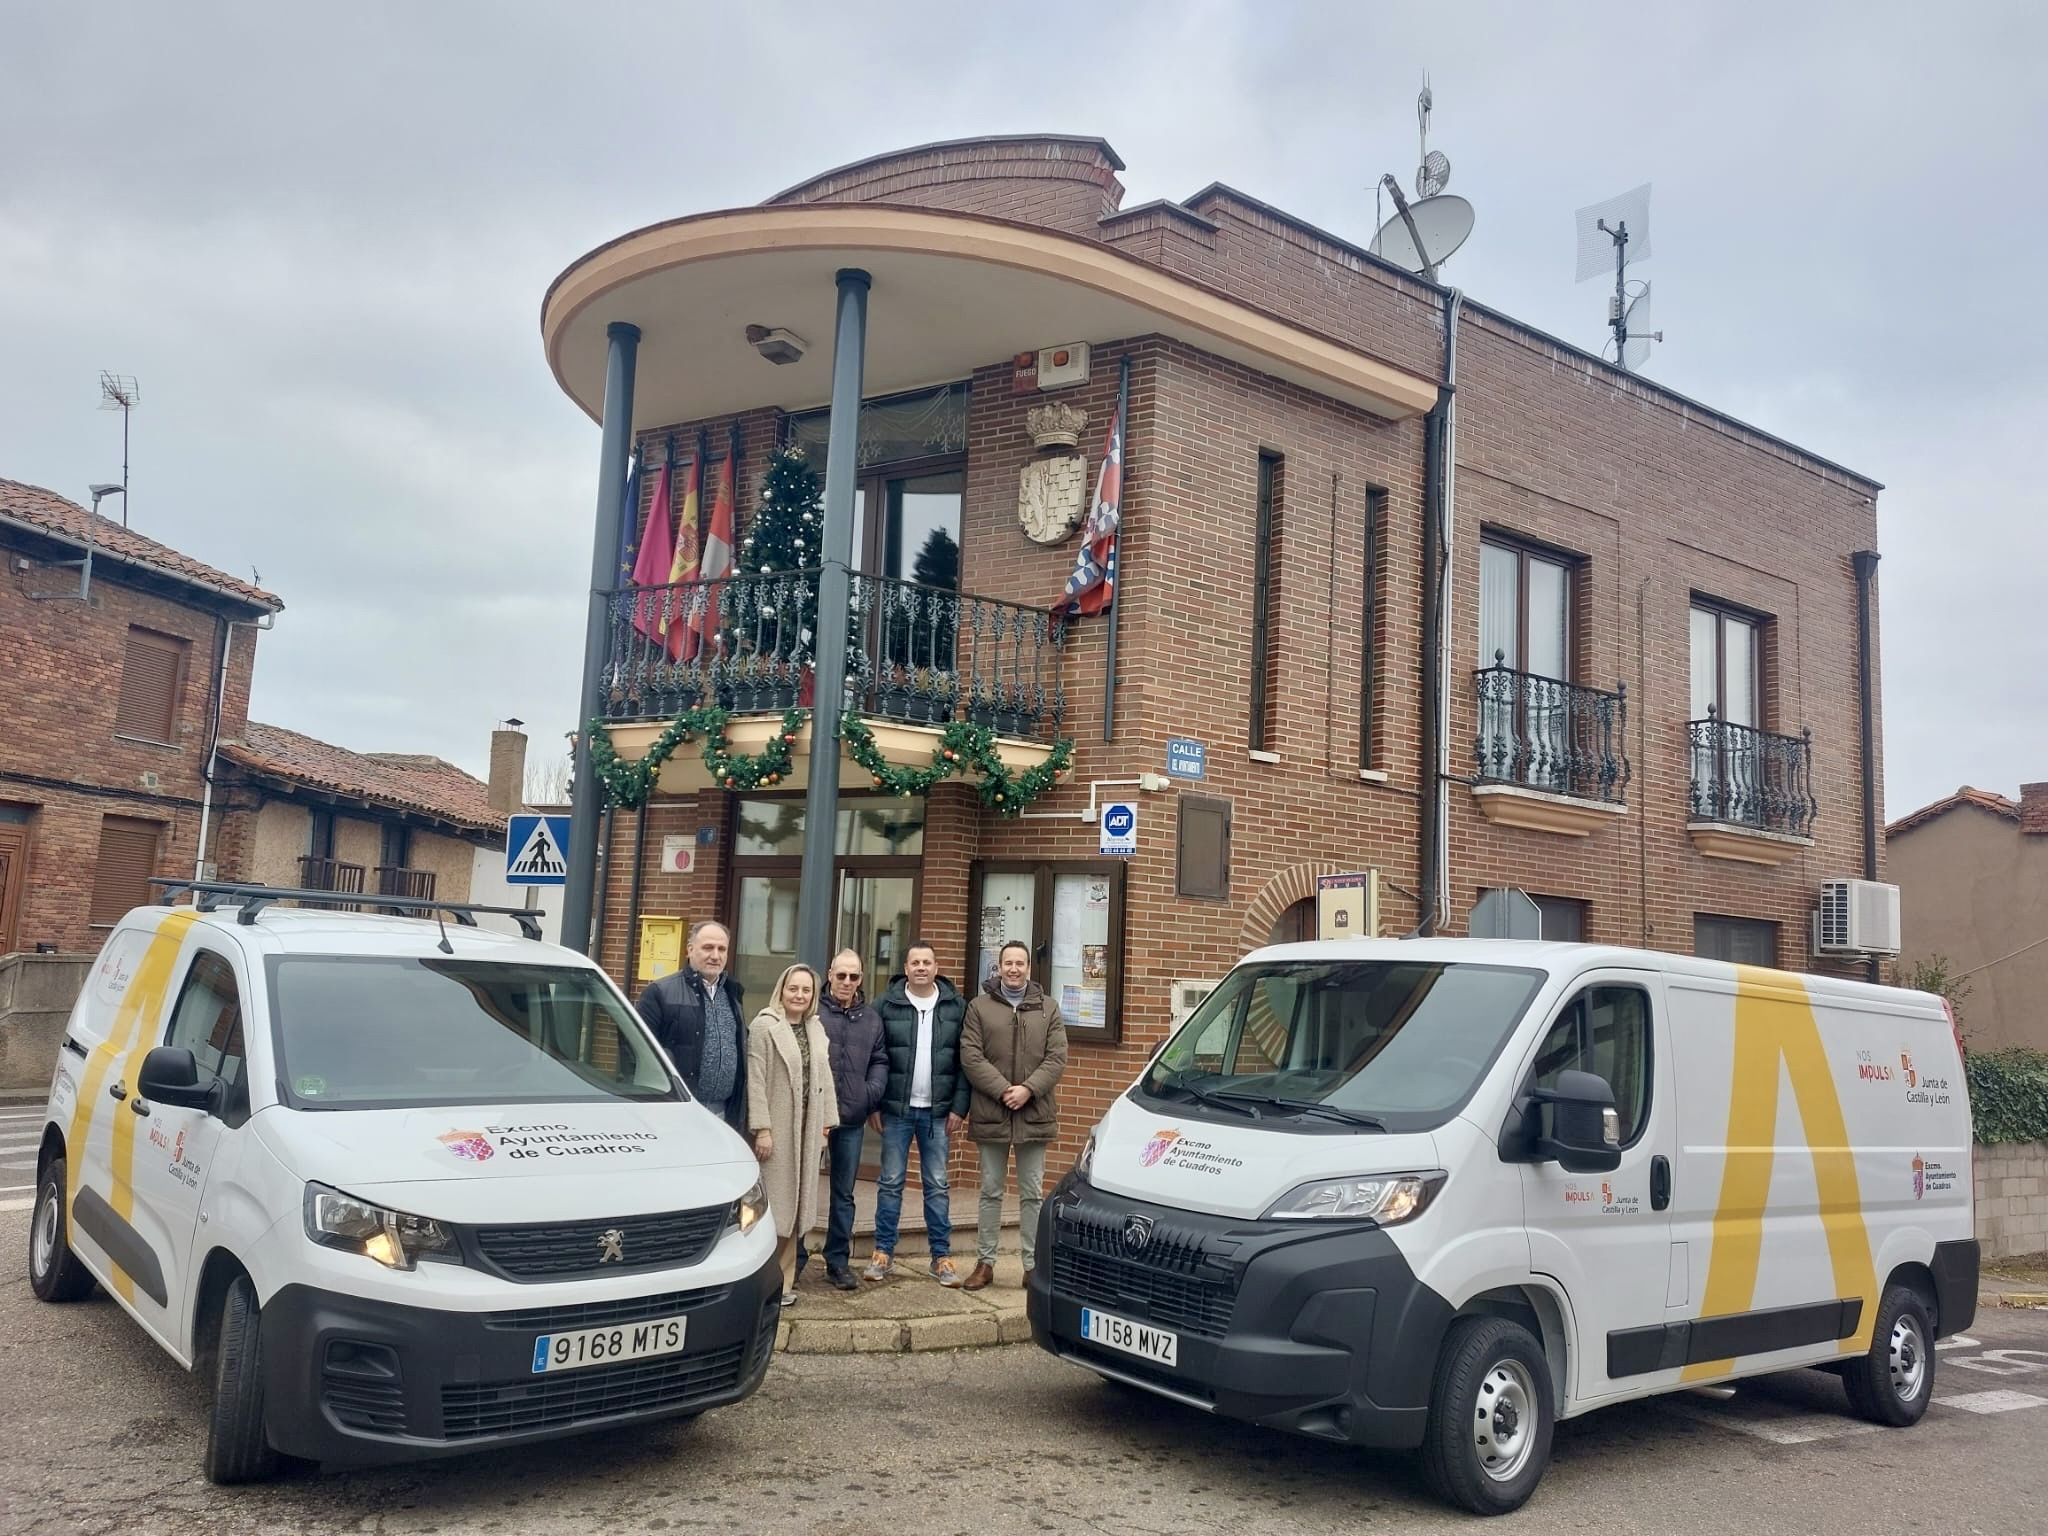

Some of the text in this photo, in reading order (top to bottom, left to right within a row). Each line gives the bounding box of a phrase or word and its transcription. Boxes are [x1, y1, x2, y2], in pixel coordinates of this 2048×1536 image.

[1015, 367, 1036, 378] FUEGO
[1172, 743, 1202, 757] CALLE
[1109, 815, 1129, 827] ADT
[1921, 1076, 1948, 1089] Junta de
[1906, 1090, 1950, 1107] Castilla y León
[485, 1122, 576, 1135] Excmo.
[499, 1131, 659, 1147] Ayuntamiento
[1176, 1137, 1212, 1150] Excmo
[508, 1143, 646, 1160] de Cuadros
[1169, 1146, 1243, 1167] Ayuntamiento
[1163, 1157, 1223, 1175] de Cuadros
[1615, 1196, 1639, 1204] Junta de
[1601, 1206, 1621, 1214] Castilla
[537, 1322, 680, 1366] E 9168 MTS
[1095, 1315, 1172, 1360] 1158 MVZ
